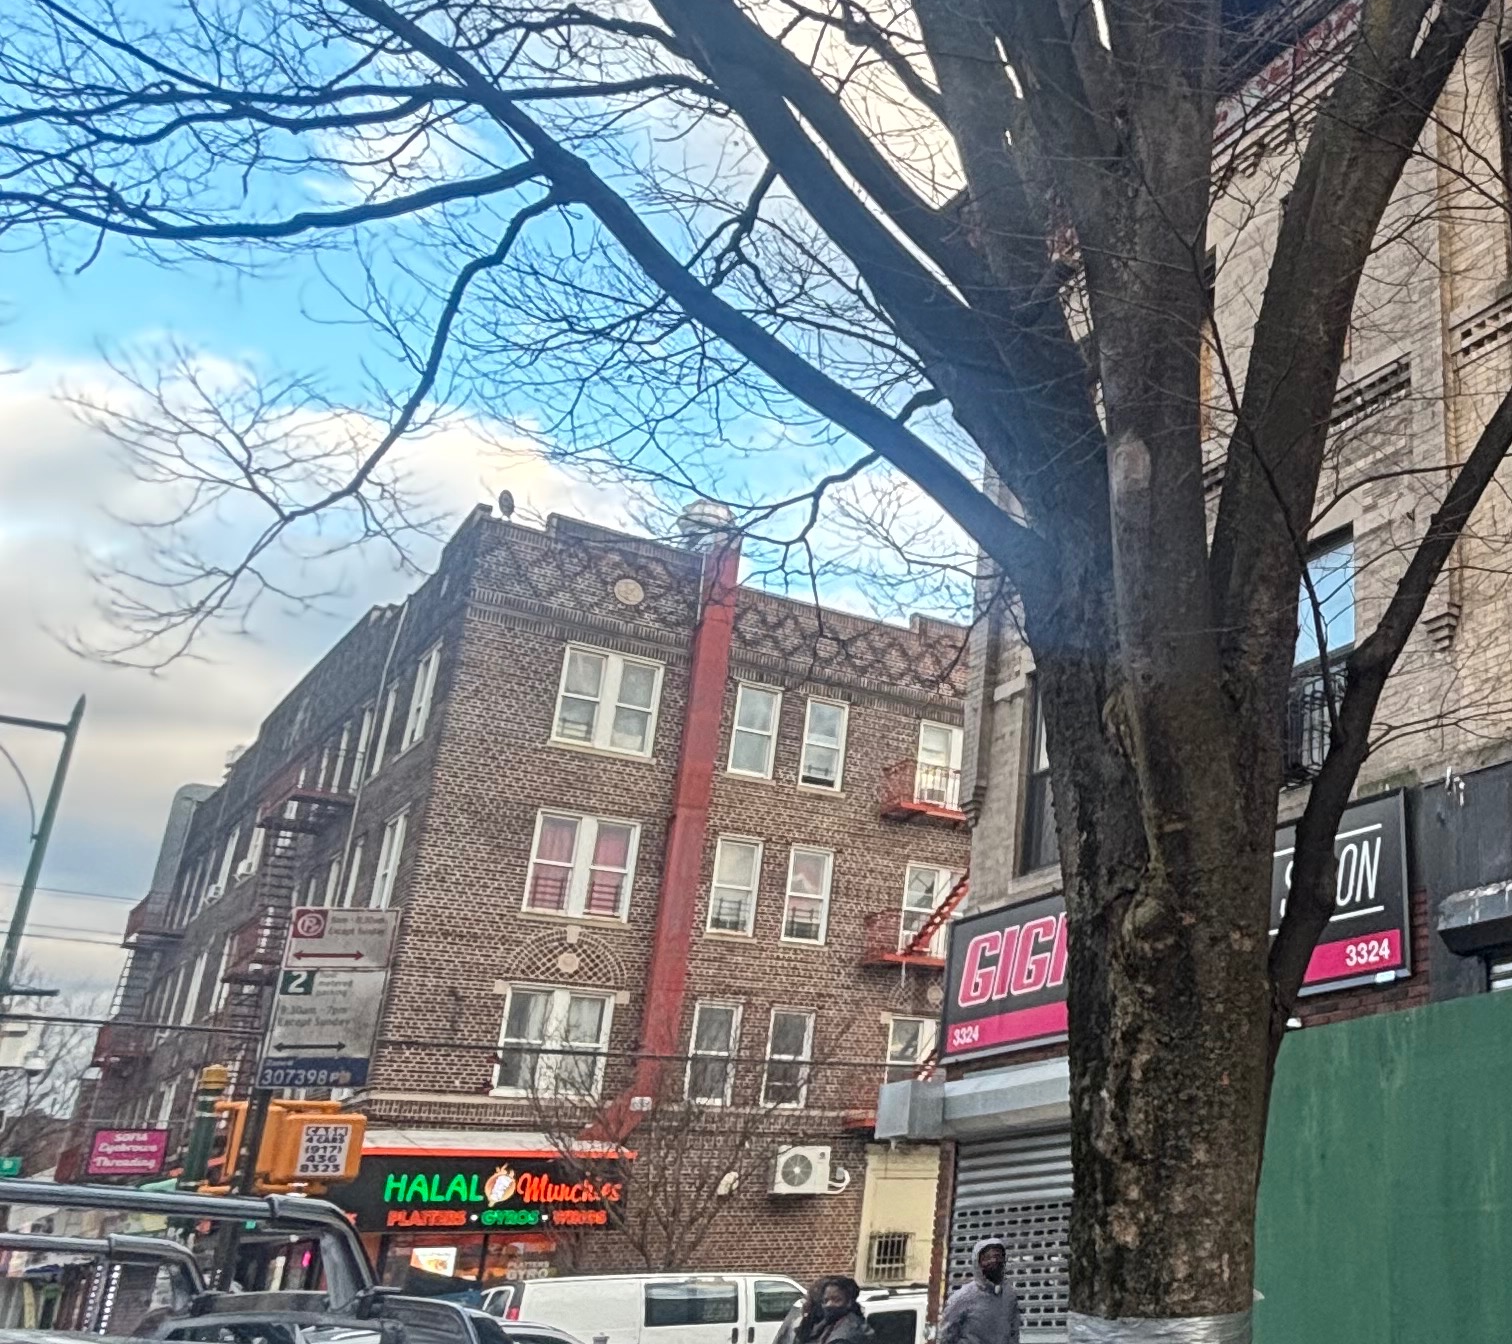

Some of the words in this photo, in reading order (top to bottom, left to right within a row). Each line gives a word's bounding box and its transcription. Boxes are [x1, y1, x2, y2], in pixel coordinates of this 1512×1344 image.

[1345, 938, 1390, 966] 3324
[953, 1025, 979, 1046] 3324
[262, 1069, 328, 1085] 307398
[383, 1173, 484, 1203] HALAL
[387, 1210, 467, 1227] PLATTERS
[481, 1210, 540, 1226] GYROS
